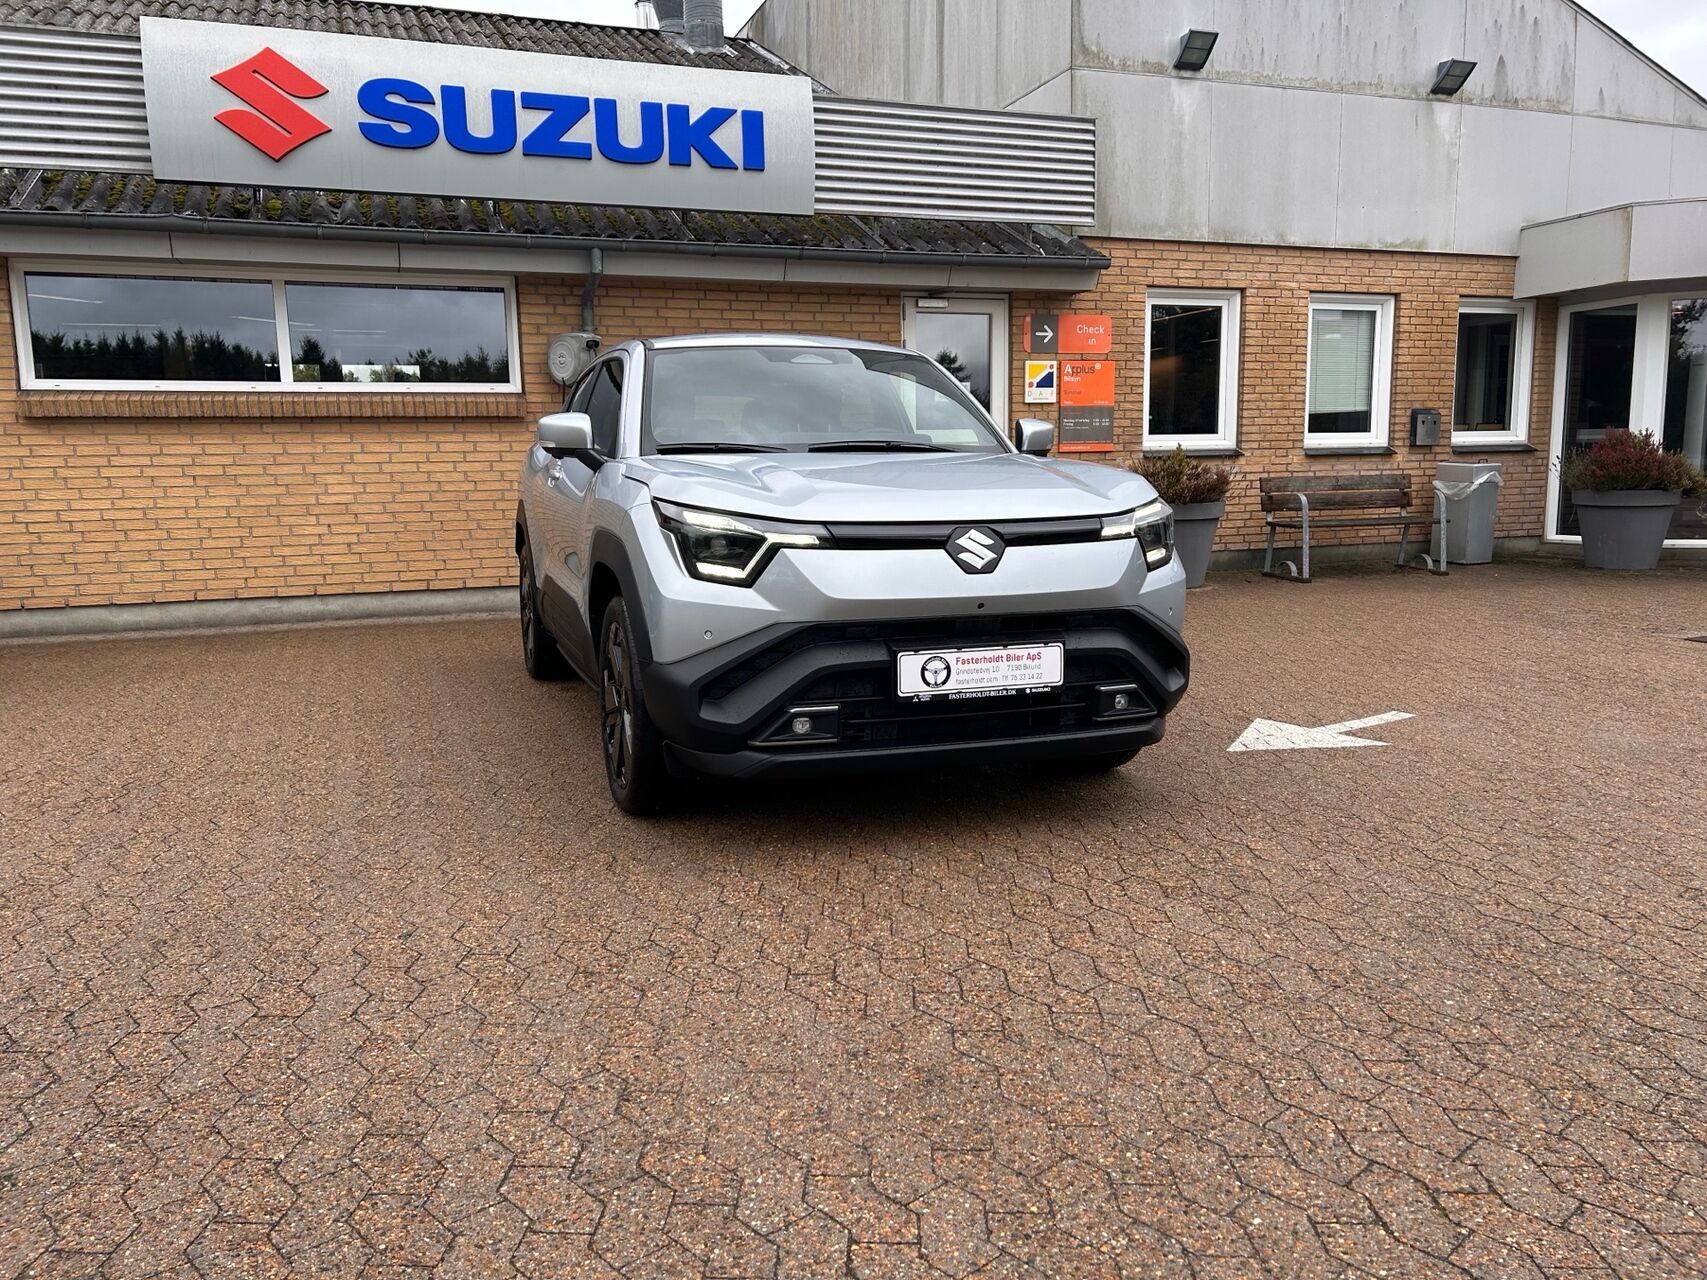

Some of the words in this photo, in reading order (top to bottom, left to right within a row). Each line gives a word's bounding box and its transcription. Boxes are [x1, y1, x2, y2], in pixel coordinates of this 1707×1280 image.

[357, 77, 766, 172] SUZUKI
[1076, 324, 1105, 334] Check
[955, 653, 1004, 666] Fasterholdt
[1005, 652, 1025, 662] Biler
[1026, 651, 1042, 663] ApS
[992, 665, 1000, 673] 10
[1006, 664, 1022, 672] 7190
[1022, 663, 1042, 671] Billund
[1027, 672, 1035, 680] 14
[1035, 672, 1043, 680] 22
